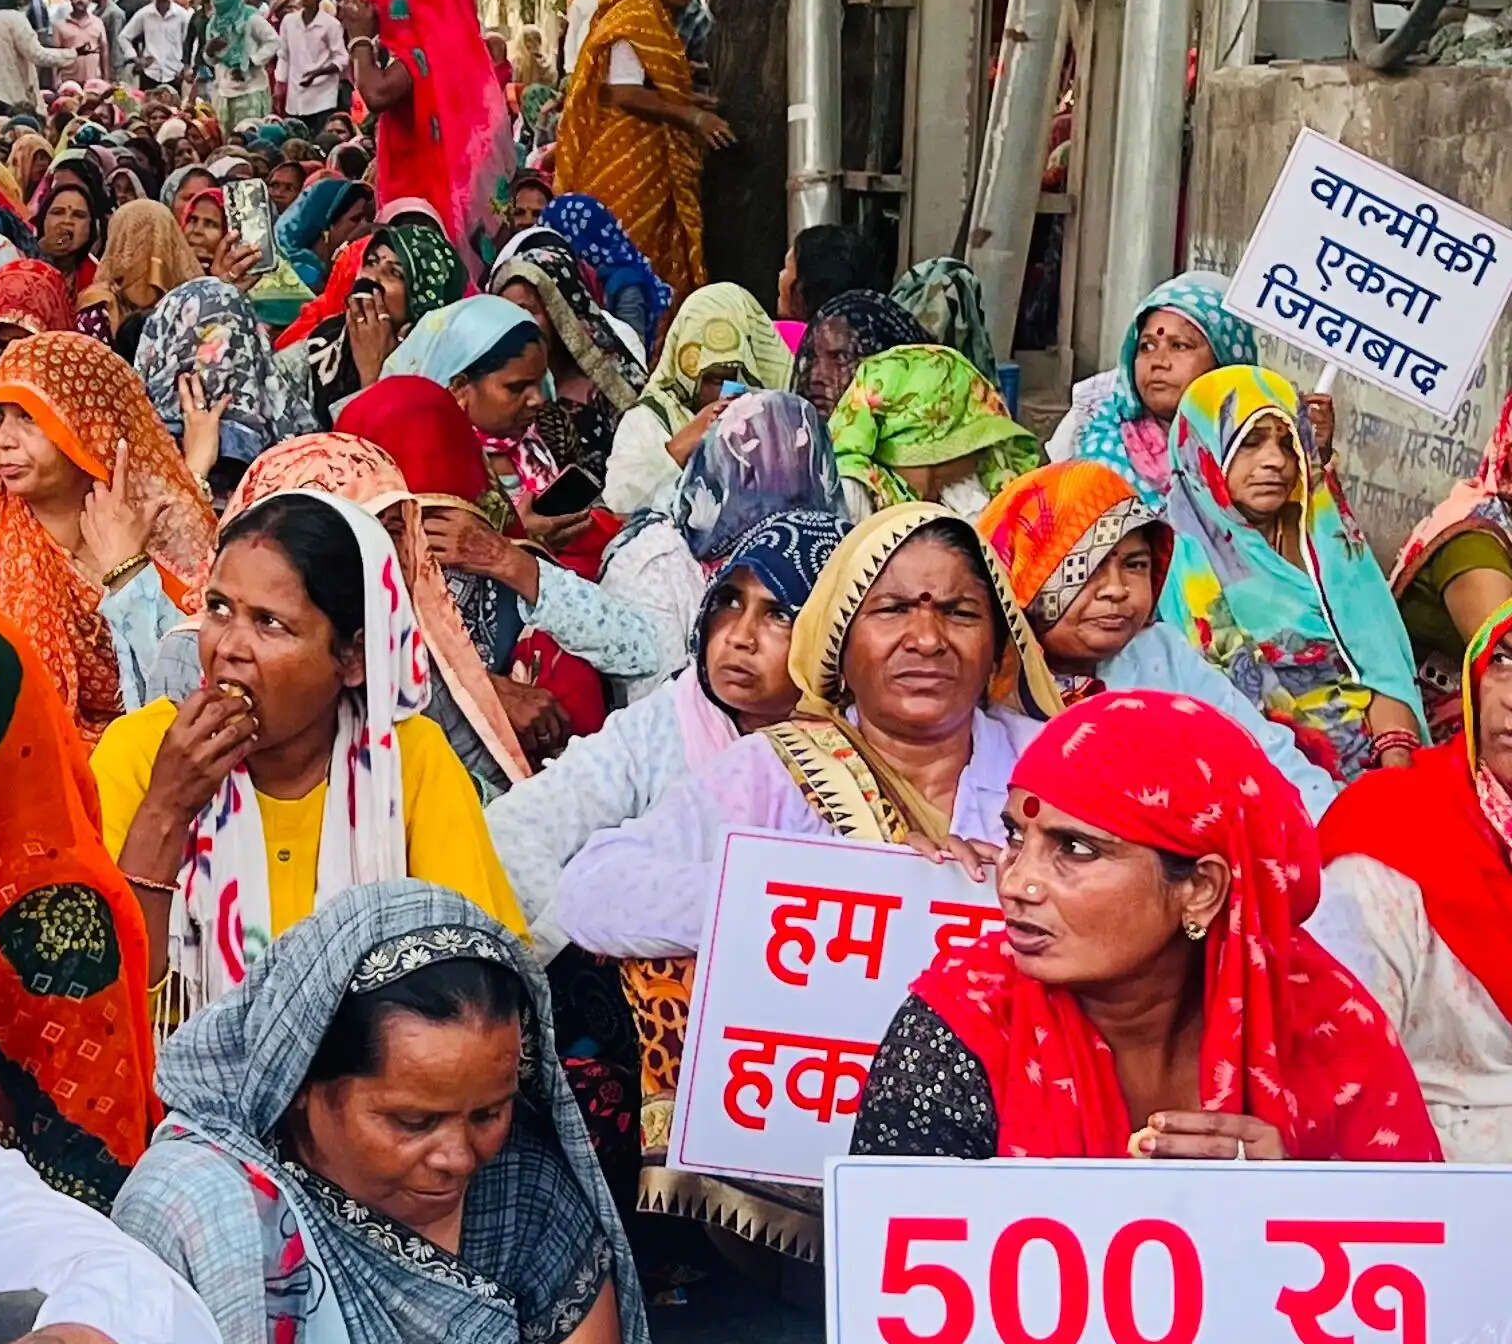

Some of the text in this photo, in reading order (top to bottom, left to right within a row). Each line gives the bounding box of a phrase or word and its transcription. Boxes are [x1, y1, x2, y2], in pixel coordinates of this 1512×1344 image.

[1310, 165, 1497, 286] वाल्मीकी
[1316, 235, 1442, 324] एकता
[765, 880, 903, 987] हम
